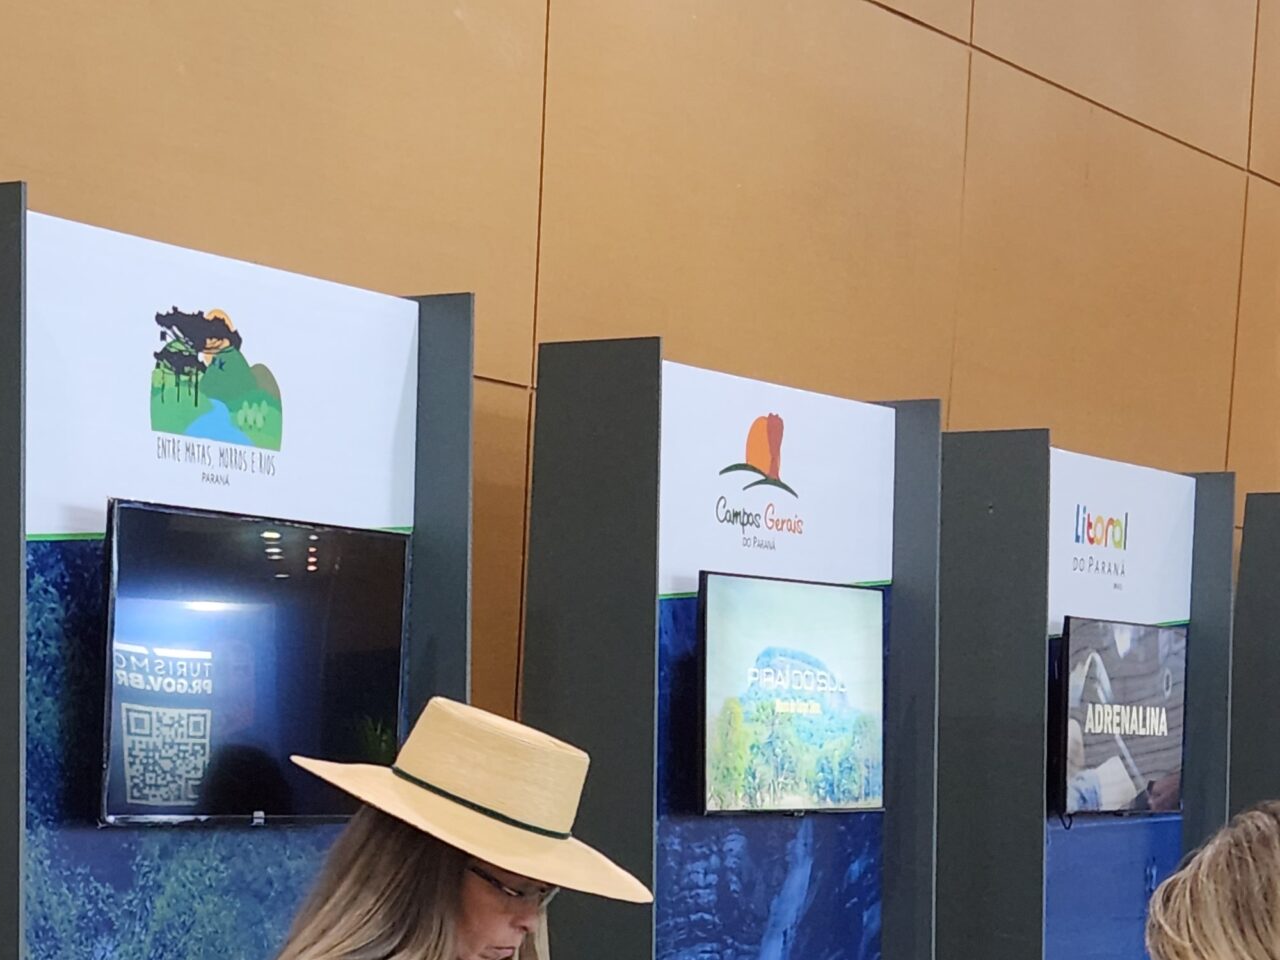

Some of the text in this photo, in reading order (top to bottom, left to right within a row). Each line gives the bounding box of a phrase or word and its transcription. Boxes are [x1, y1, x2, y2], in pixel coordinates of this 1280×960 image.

[156, 437, 181, 462] ENTRE
[219, 446, 247, 472] MORROS
[251, 451, 256, 473] E
[259, 453, 276, 476] RIOS
[201, 472, 230, 486] PARANÁ
[716, 496, 803, 535] Campos Gerais
[1074, 504, 1129, 550] Litoral
[1072, 556, 1125, 577] DO PARANÁ
[1085, 703, 1168, 736] ADRENALINA
